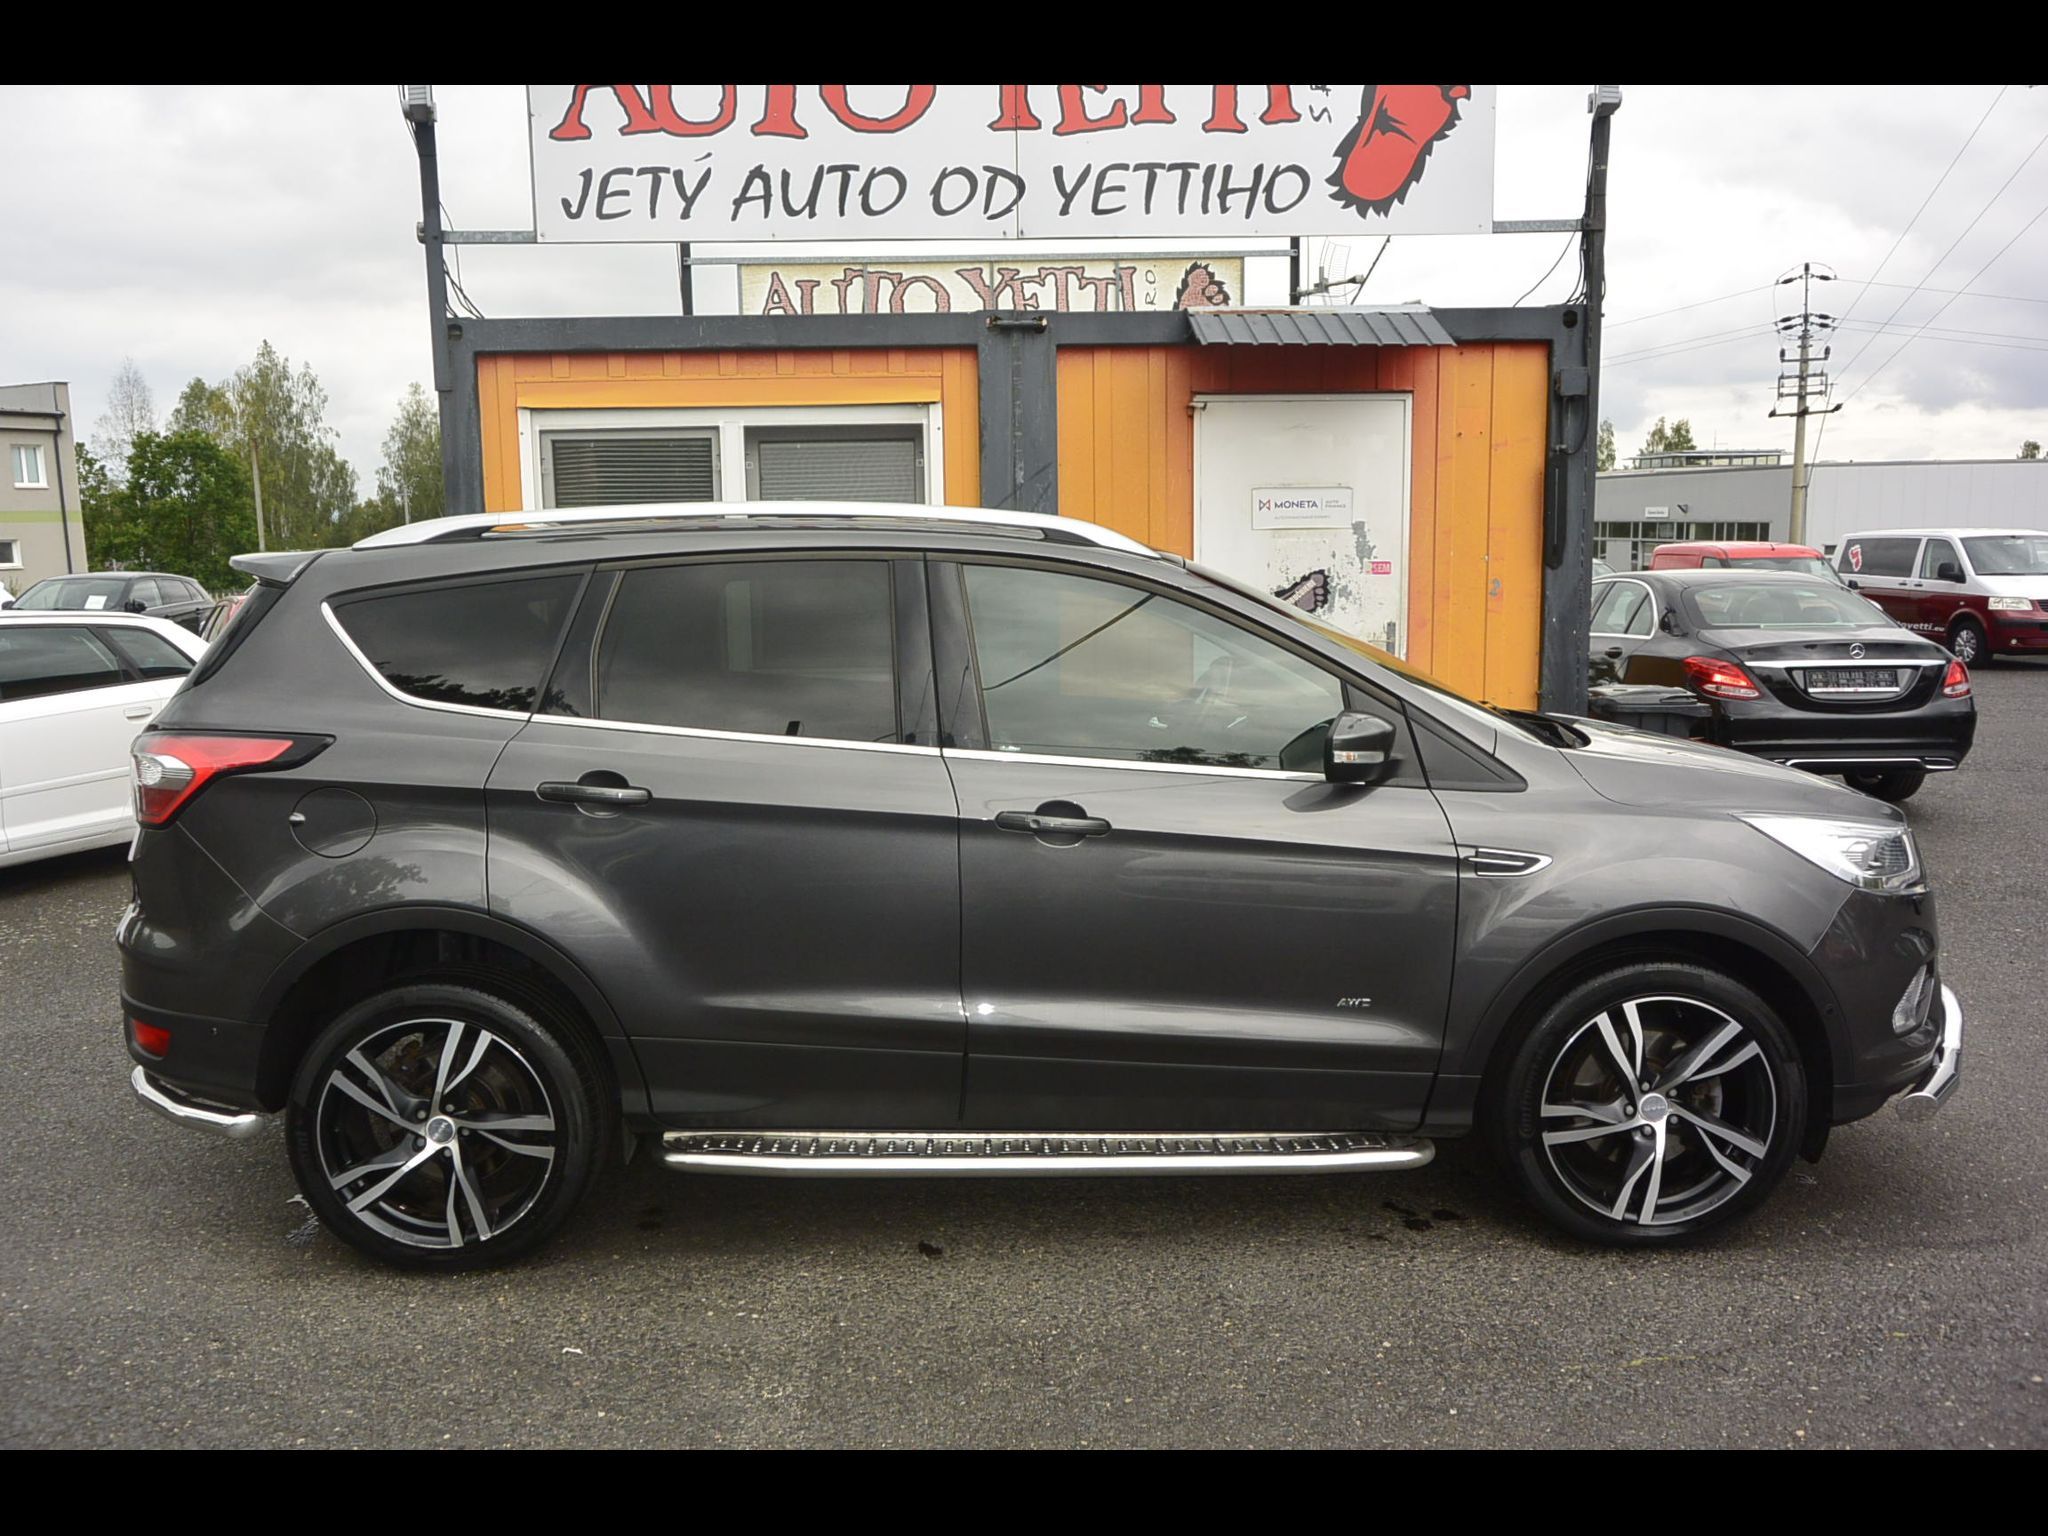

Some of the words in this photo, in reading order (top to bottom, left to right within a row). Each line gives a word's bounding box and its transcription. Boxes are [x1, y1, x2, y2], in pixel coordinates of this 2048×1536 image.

[561, 152, 713, 221] JETÝ
[731, 164, 908, 221] AUTO
[931, 165, 1026, 220] OD
[1053, 162, 1311, 220] YETTIHO
[1274, 500, 1319, 509] MONETA
